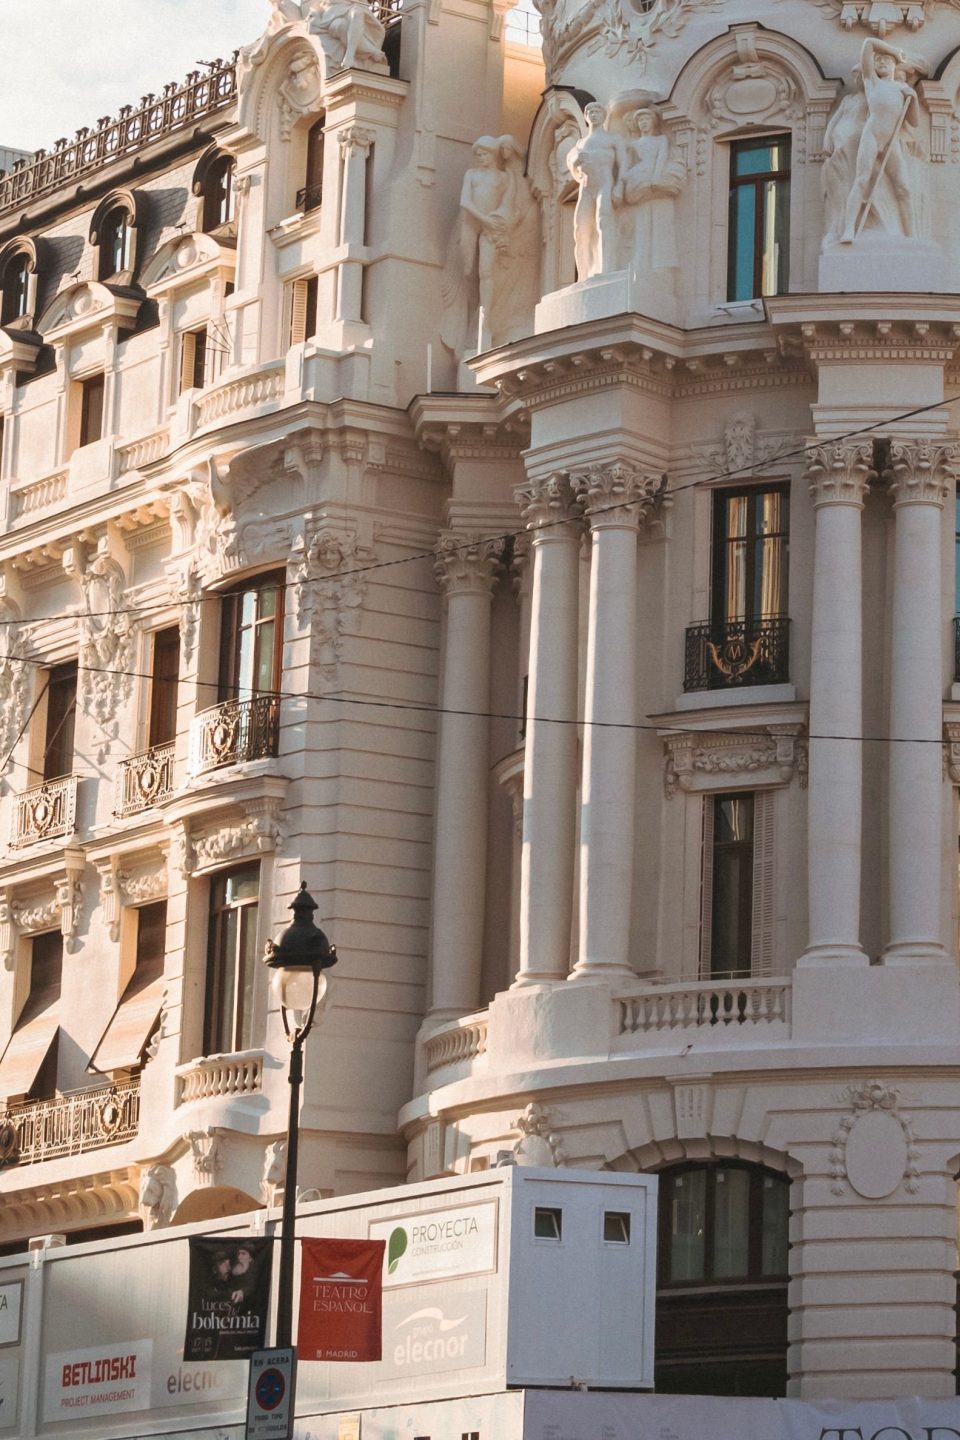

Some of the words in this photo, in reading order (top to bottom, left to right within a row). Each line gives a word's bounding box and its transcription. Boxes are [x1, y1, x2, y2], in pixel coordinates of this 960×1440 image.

[412, 1217, 478, 1244] PROYECTA
[312, 1285, 368, 1300] TEATRO
[313, 1300, 373, 1313] ESPAÑOL
[192, 1310, 260, 1329] bohemia
[326, 1350, 358, 1358] MADRID
[394, 1334, 468, 1366] elecnor
[62, 1355, 137, 1387] BETLINSKI
[61, 1395, 88, 1408] PROJECT
[91, 1389, 135, 1403] MANAGEMENT
